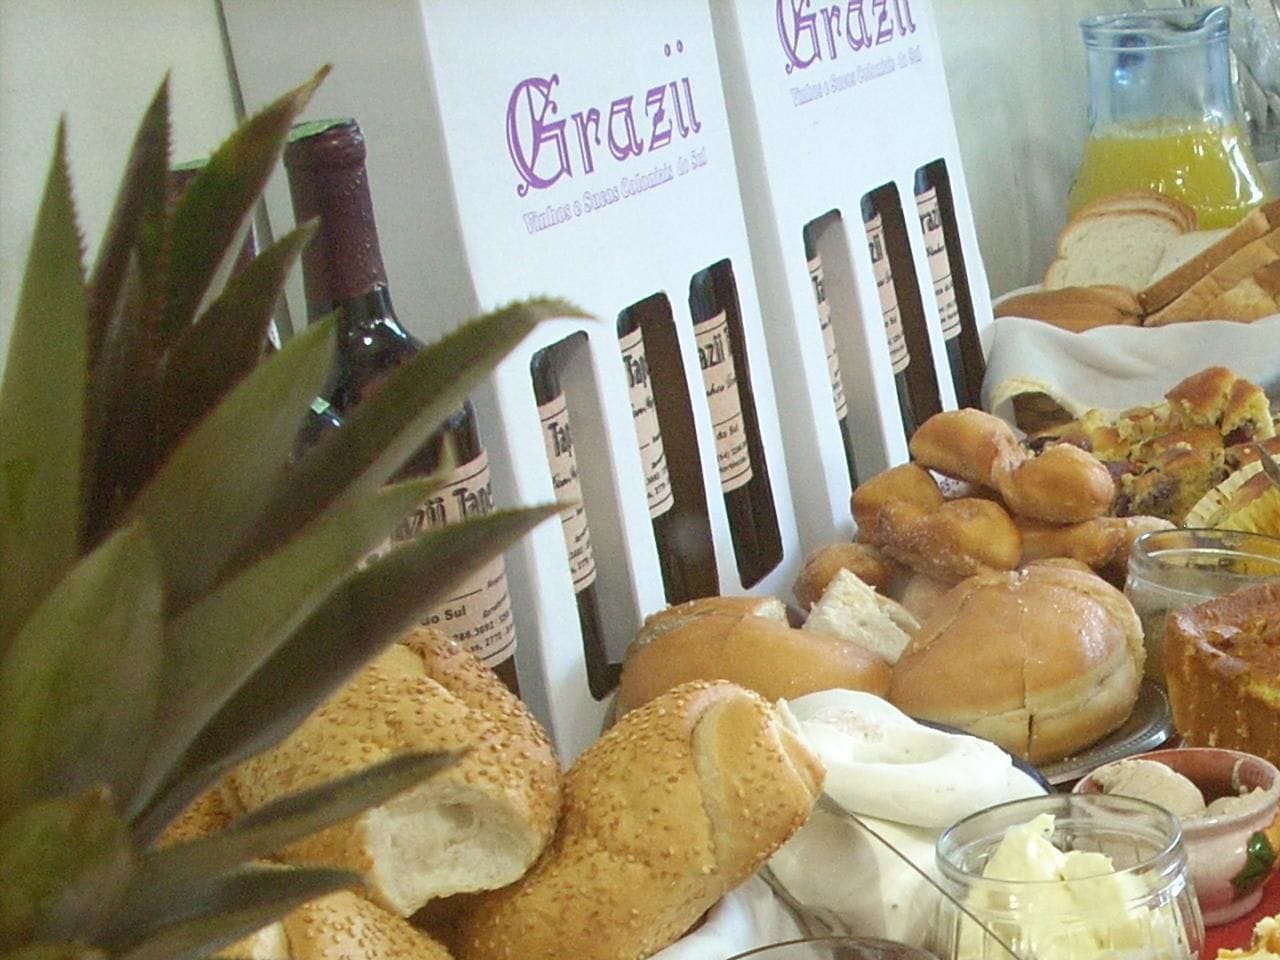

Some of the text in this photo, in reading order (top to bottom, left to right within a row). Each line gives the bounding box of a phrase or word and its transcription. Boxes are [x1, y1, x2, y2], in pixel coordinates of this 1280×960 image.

[522, 145, 708, 234] Vinhos e Sucos Coloniais do Sul
[444, 605, 468, 622] Sul
